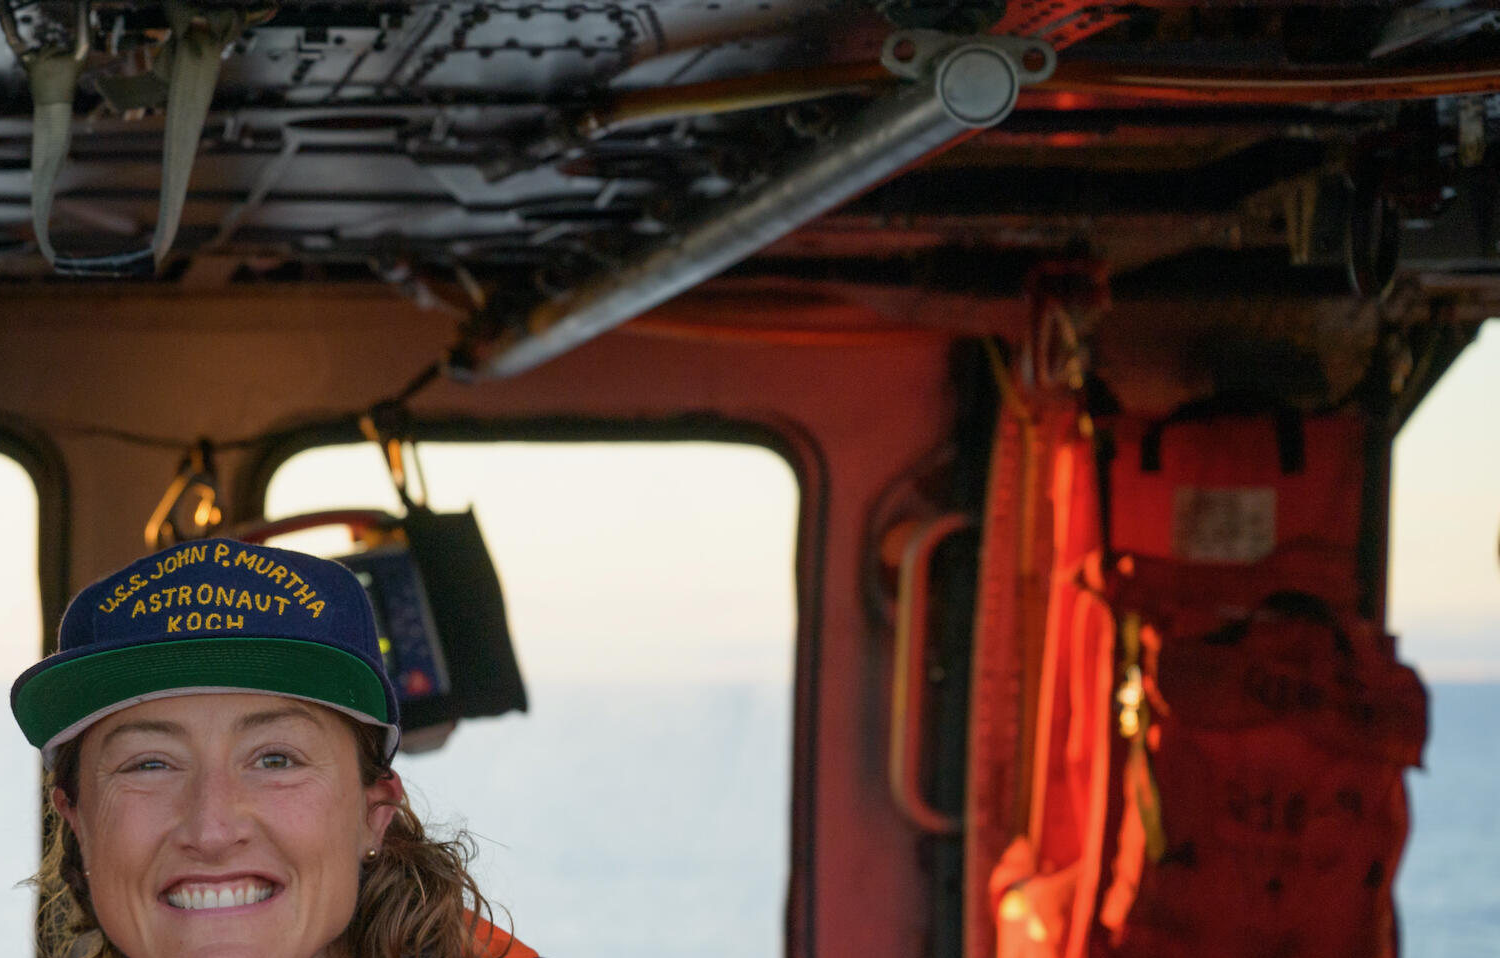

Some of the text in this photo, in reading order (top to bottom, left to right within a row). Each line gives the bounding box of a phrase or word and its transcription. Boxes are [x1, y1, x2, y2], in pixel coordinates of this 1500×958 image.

[150, 544, 208, 581] JOHN
[233, 549, 327, 620] MURTHA
[130, 583, 292, 619] ASTRONAUT
[166, 611, 245, 633] KOCH
